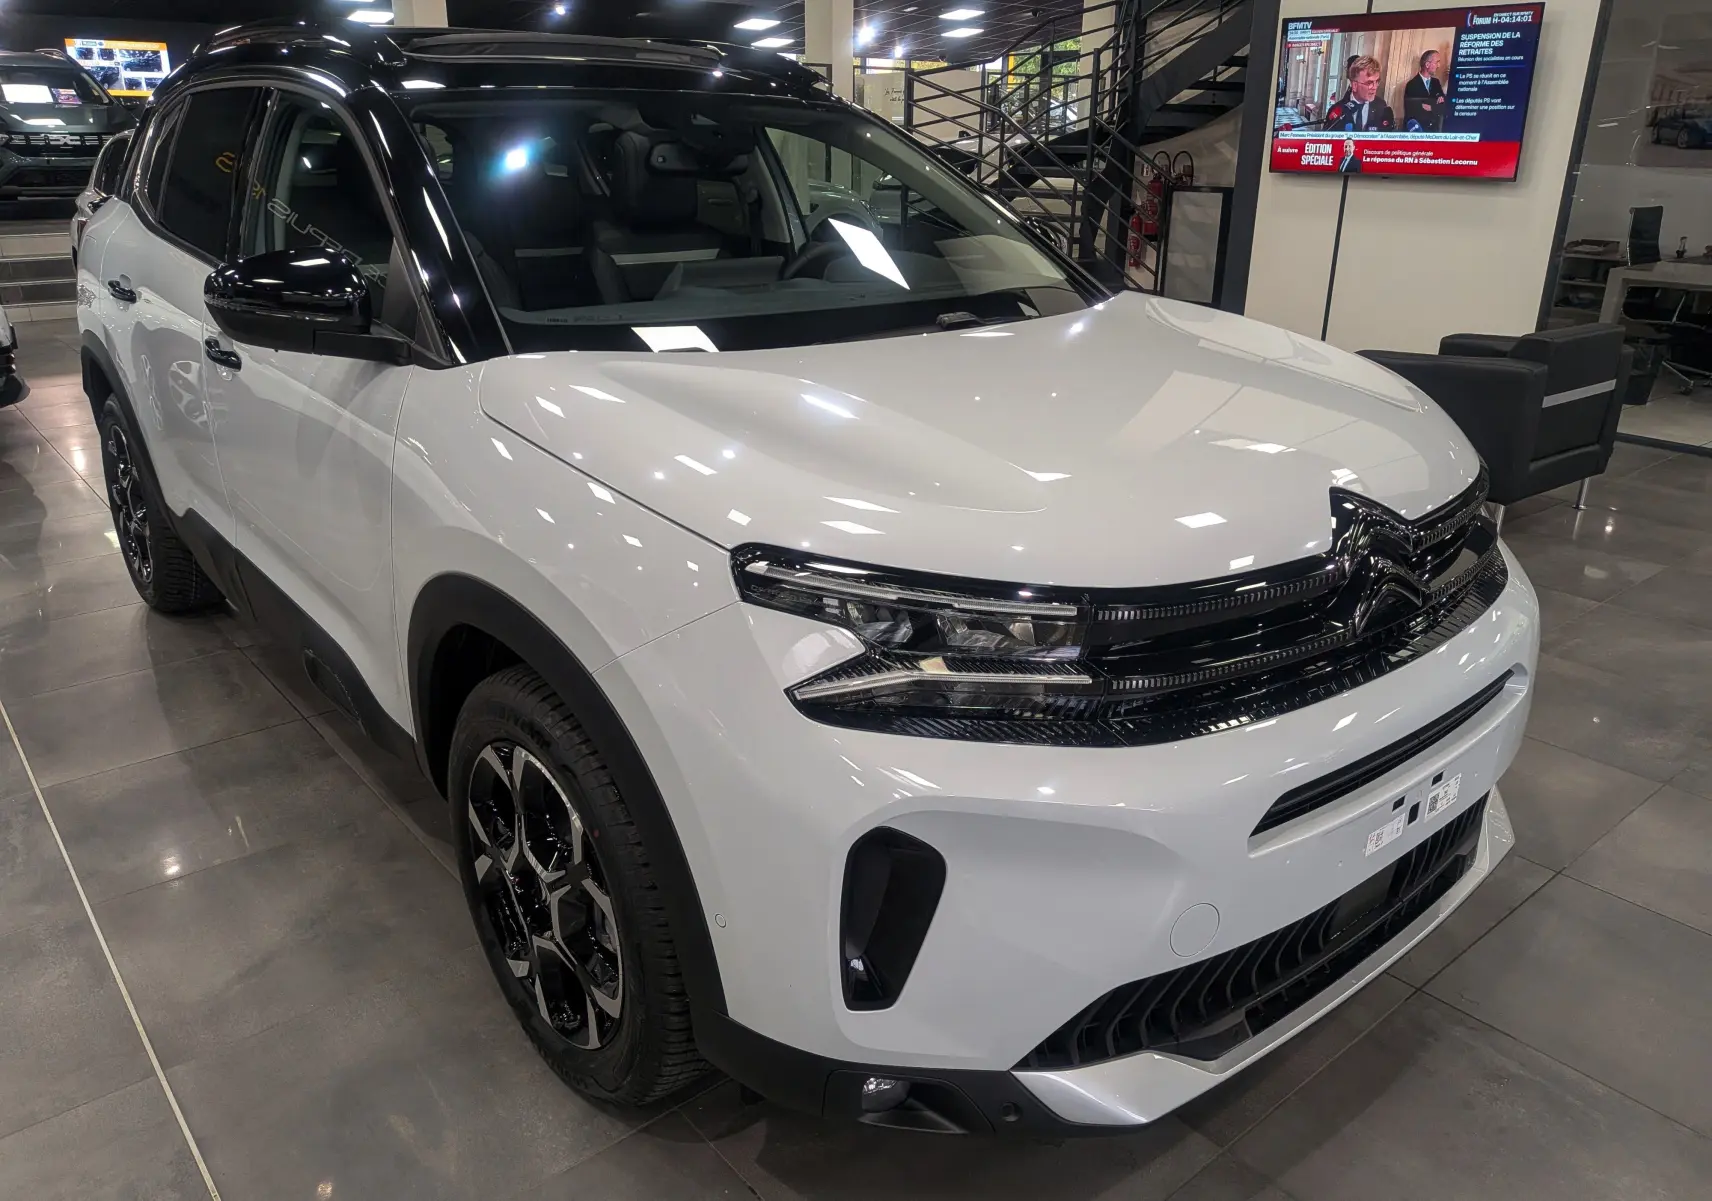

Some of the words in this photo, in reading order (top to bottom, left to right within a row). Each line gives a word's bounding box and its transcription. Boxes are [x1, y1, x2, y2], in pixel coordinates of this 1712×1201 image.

[1288, 22, 1312, 30] BFMTV
[1305, 142, 1332, 154] ÉDITION
[1301, 154, 1333, 166] SPÉCIALE
